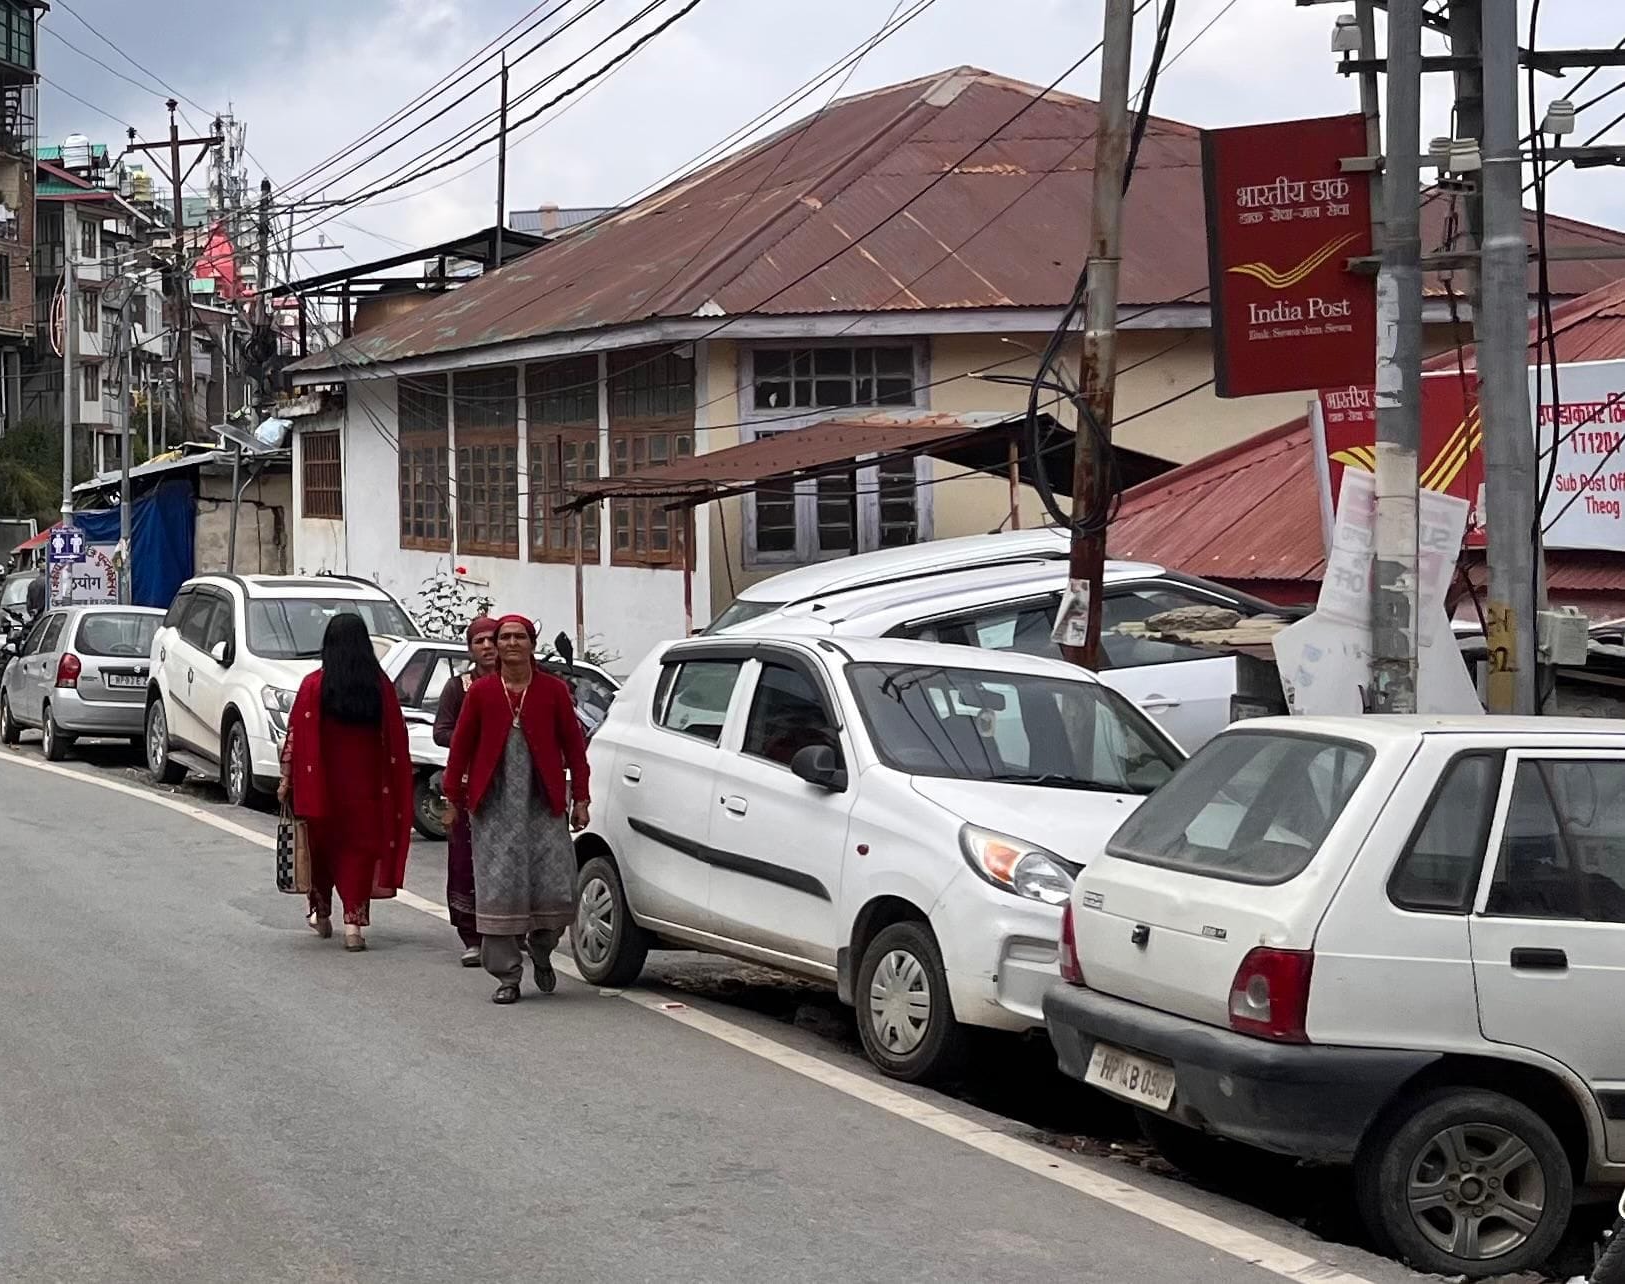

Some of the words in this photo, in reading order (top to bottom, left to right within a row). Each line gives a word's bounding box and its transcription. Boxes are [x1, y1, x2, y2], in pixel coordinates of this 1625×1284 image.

[1236, 176, 1307, 208] भारतीय
[1310, 178, 1350, 201] डाक
[1248, 300, 1303, 325] India
[1307, 297, 1352, 319] Post
[1325, 385, 1370, 409] भारतीय
[1556, 473, 1577, 492] Sub
[1580, 474, 1606, 492] Post
[1584, 495, 1620, 519] Theog
